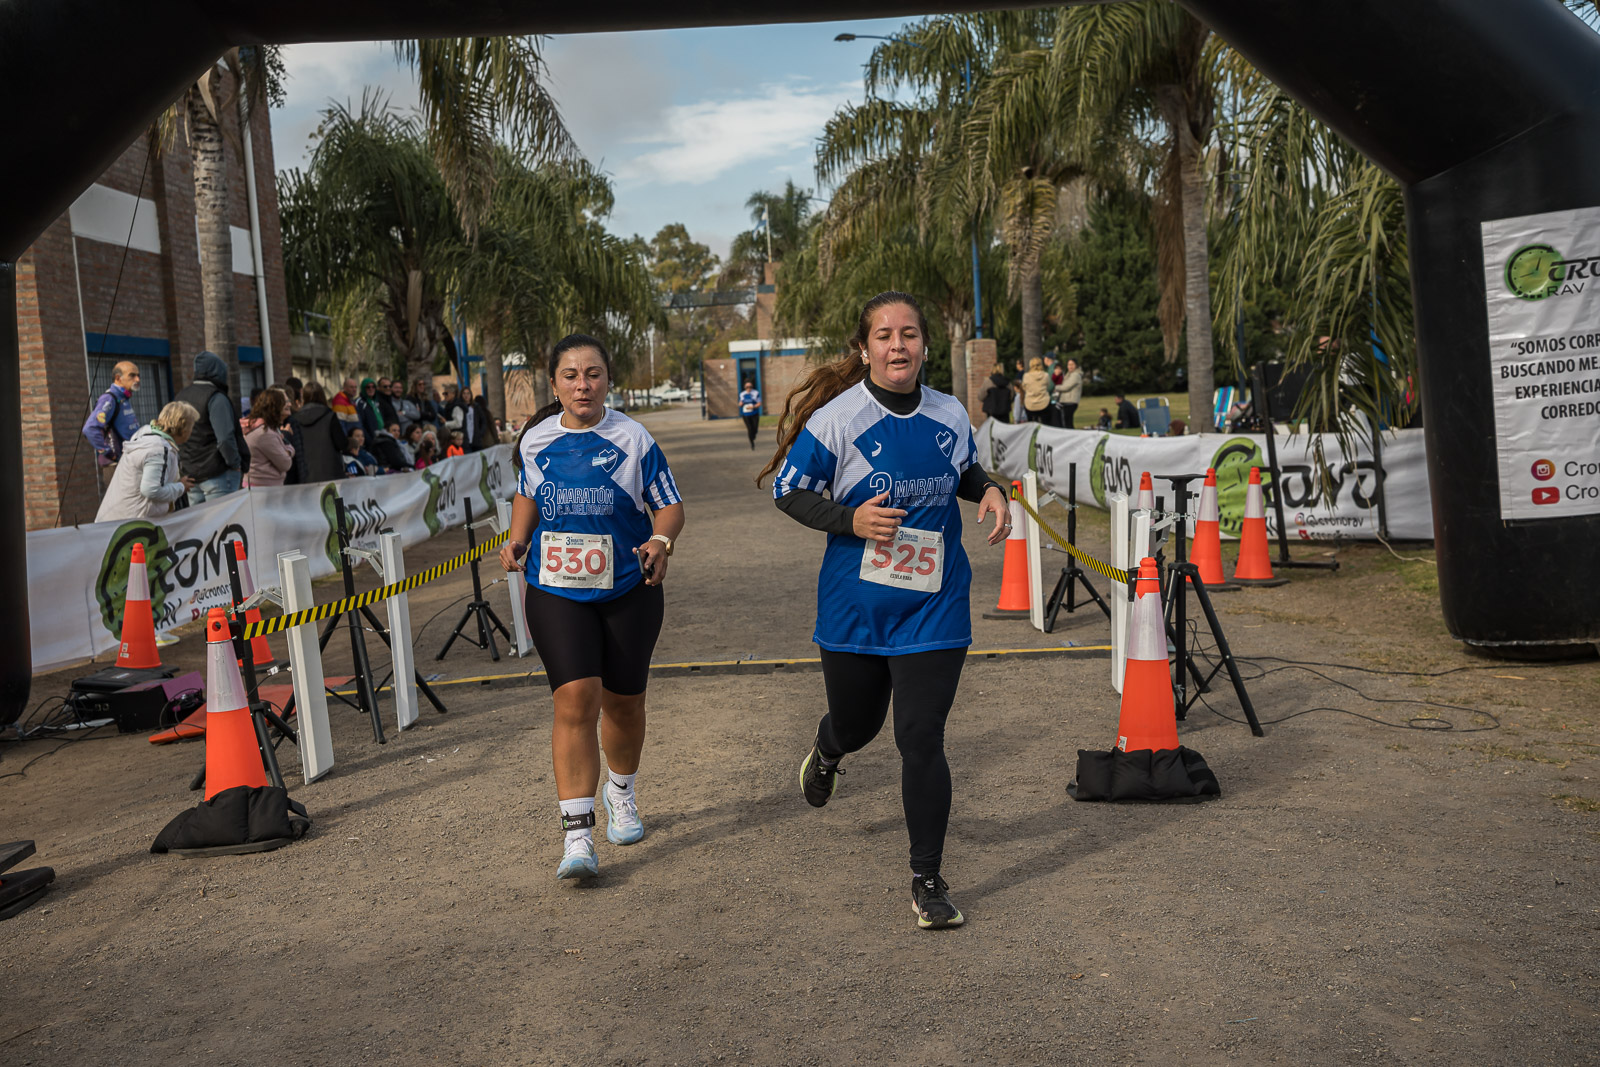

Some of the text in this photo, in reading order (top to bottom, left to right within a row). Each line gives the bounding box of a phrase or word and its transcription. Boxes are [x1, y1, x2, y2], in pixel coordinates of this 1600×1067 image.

[1547, 282, 1585, 297] RAV
[1500, 356, 1600, 379] BUSCANDO ME
[1564, 461, 1600, 477] Cro
[894, 473, 955, 498] MARATÓN
[540, 481, 614, 521] 3 MARATÓN
[545, 546, 607, 575] 530
[871, 541, 937, 576] 525
